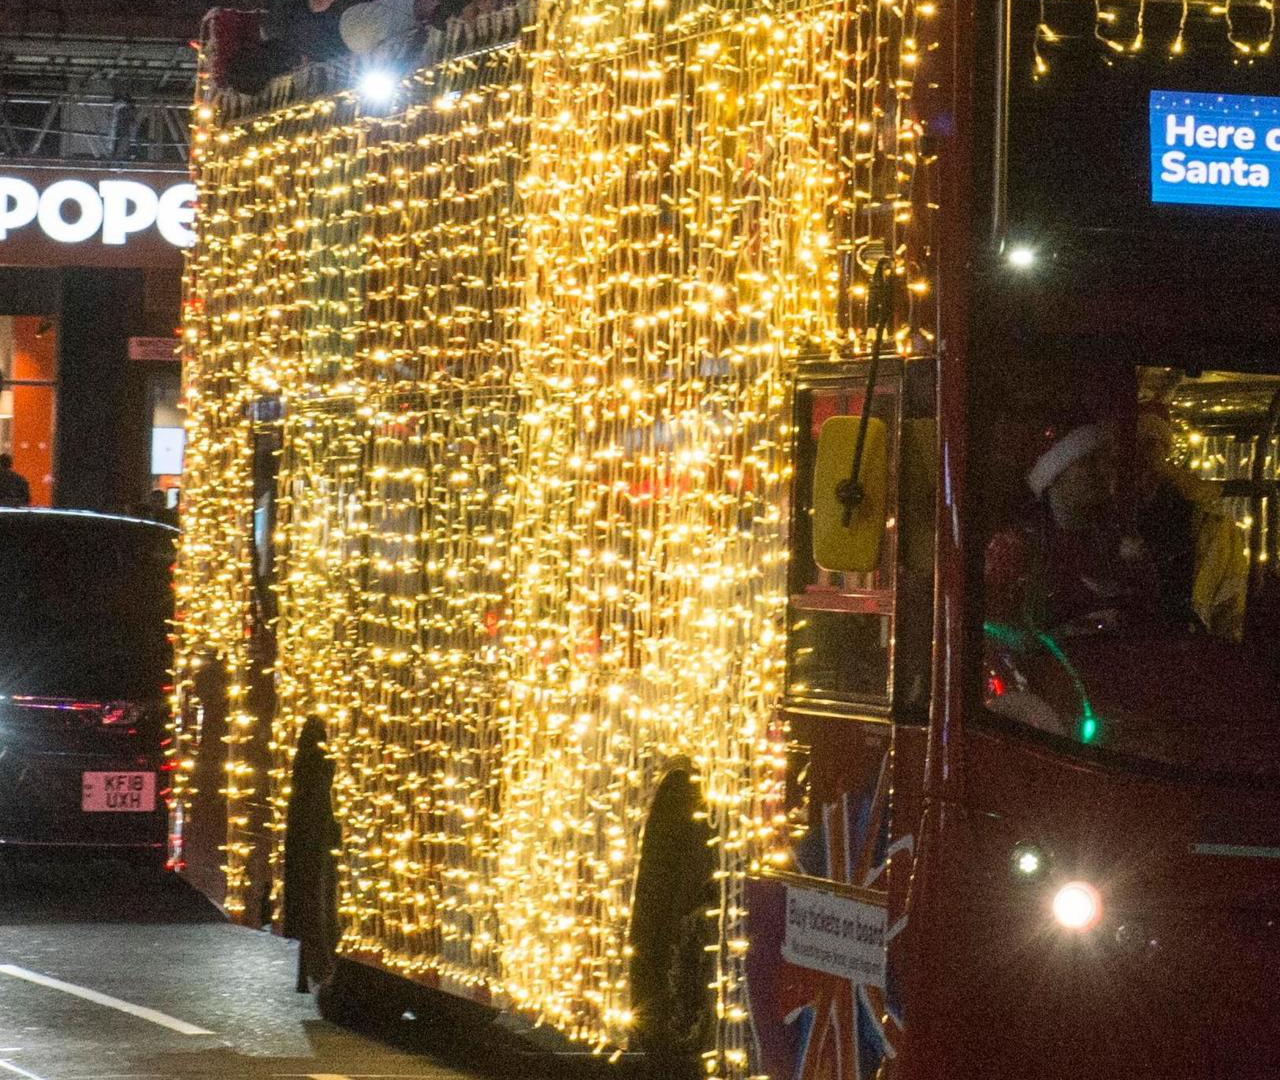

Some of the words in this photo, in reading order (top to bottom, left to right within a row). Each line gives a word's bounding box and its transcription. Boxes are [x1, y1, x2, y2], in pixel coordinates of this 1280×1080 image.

[1163, 115, 1256, 151] Here
[1160, 151, 1269, 189] Santa
[104, 774, 144, 791] KF18
[106, 792, 141, 808] UXH
